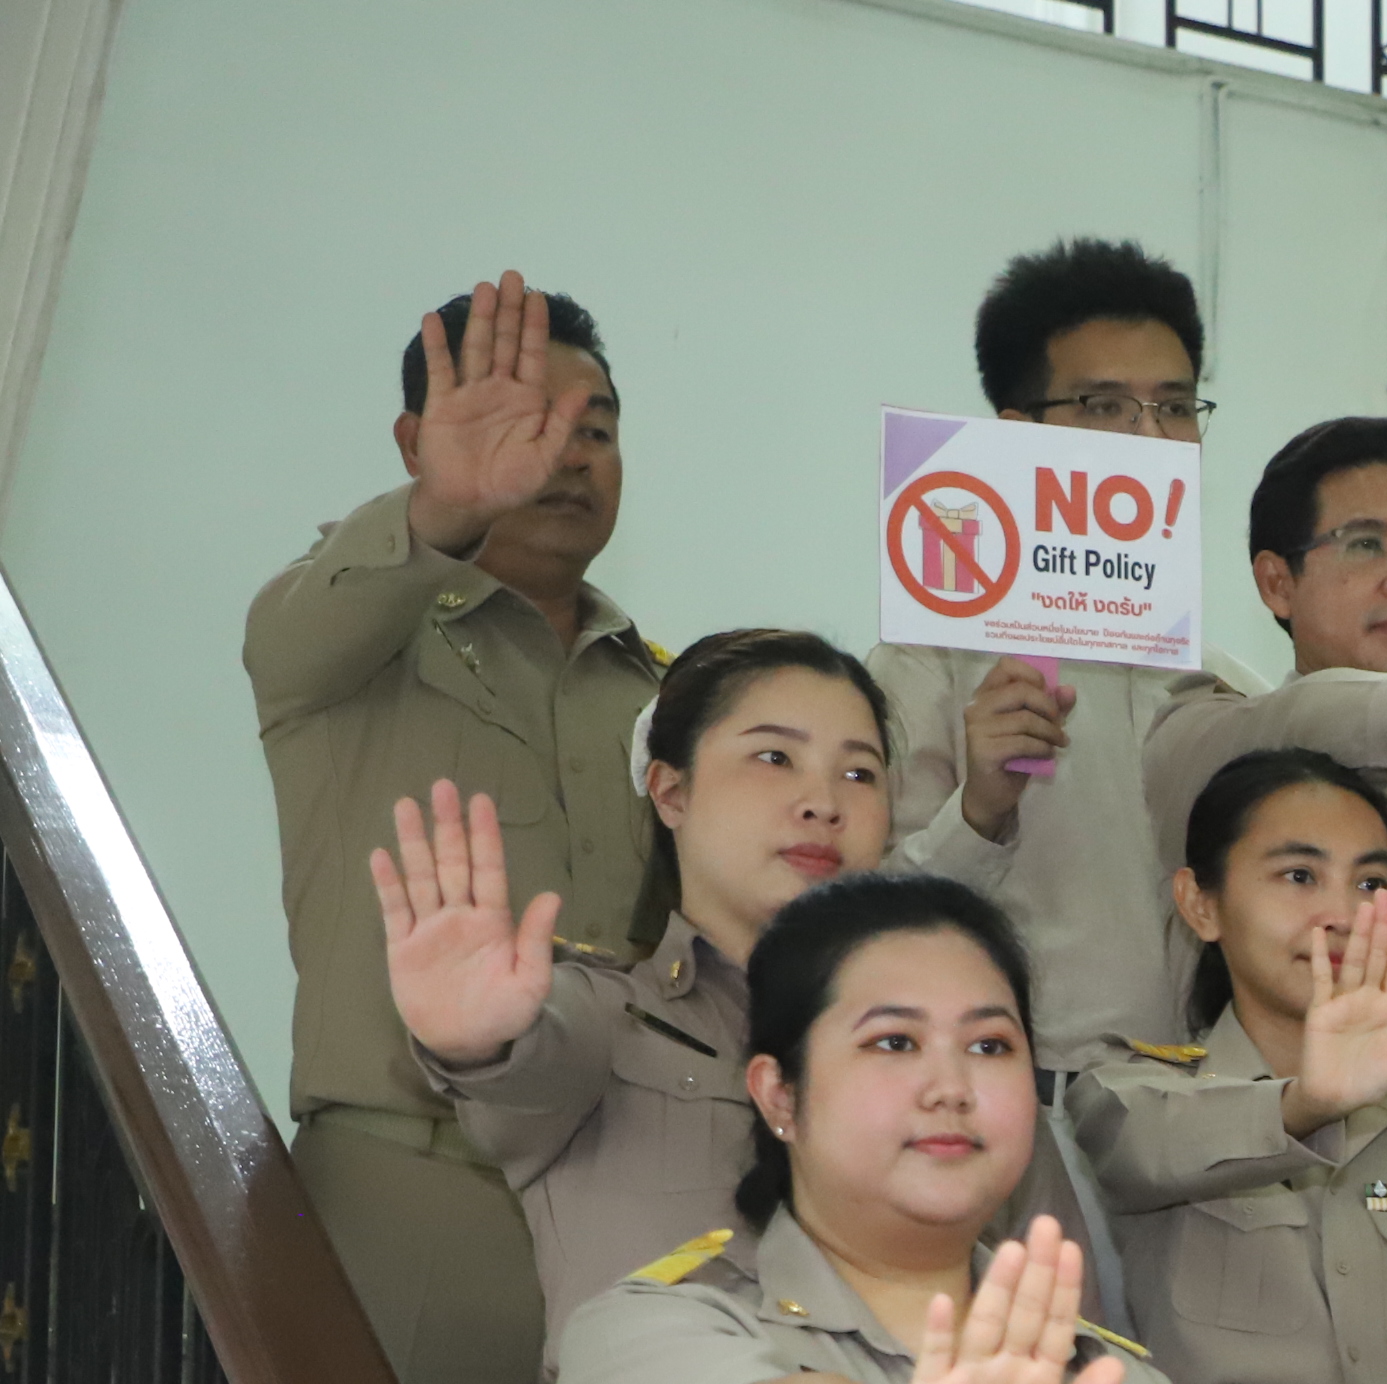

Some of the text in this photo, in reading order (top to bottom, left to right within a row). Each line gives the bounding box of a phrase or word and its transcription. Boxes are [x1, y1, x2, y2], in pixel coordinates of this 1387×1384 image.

[1035, 466, 1186, 542] NO!
[1032, 544, 1156, 590] Gift Policy
